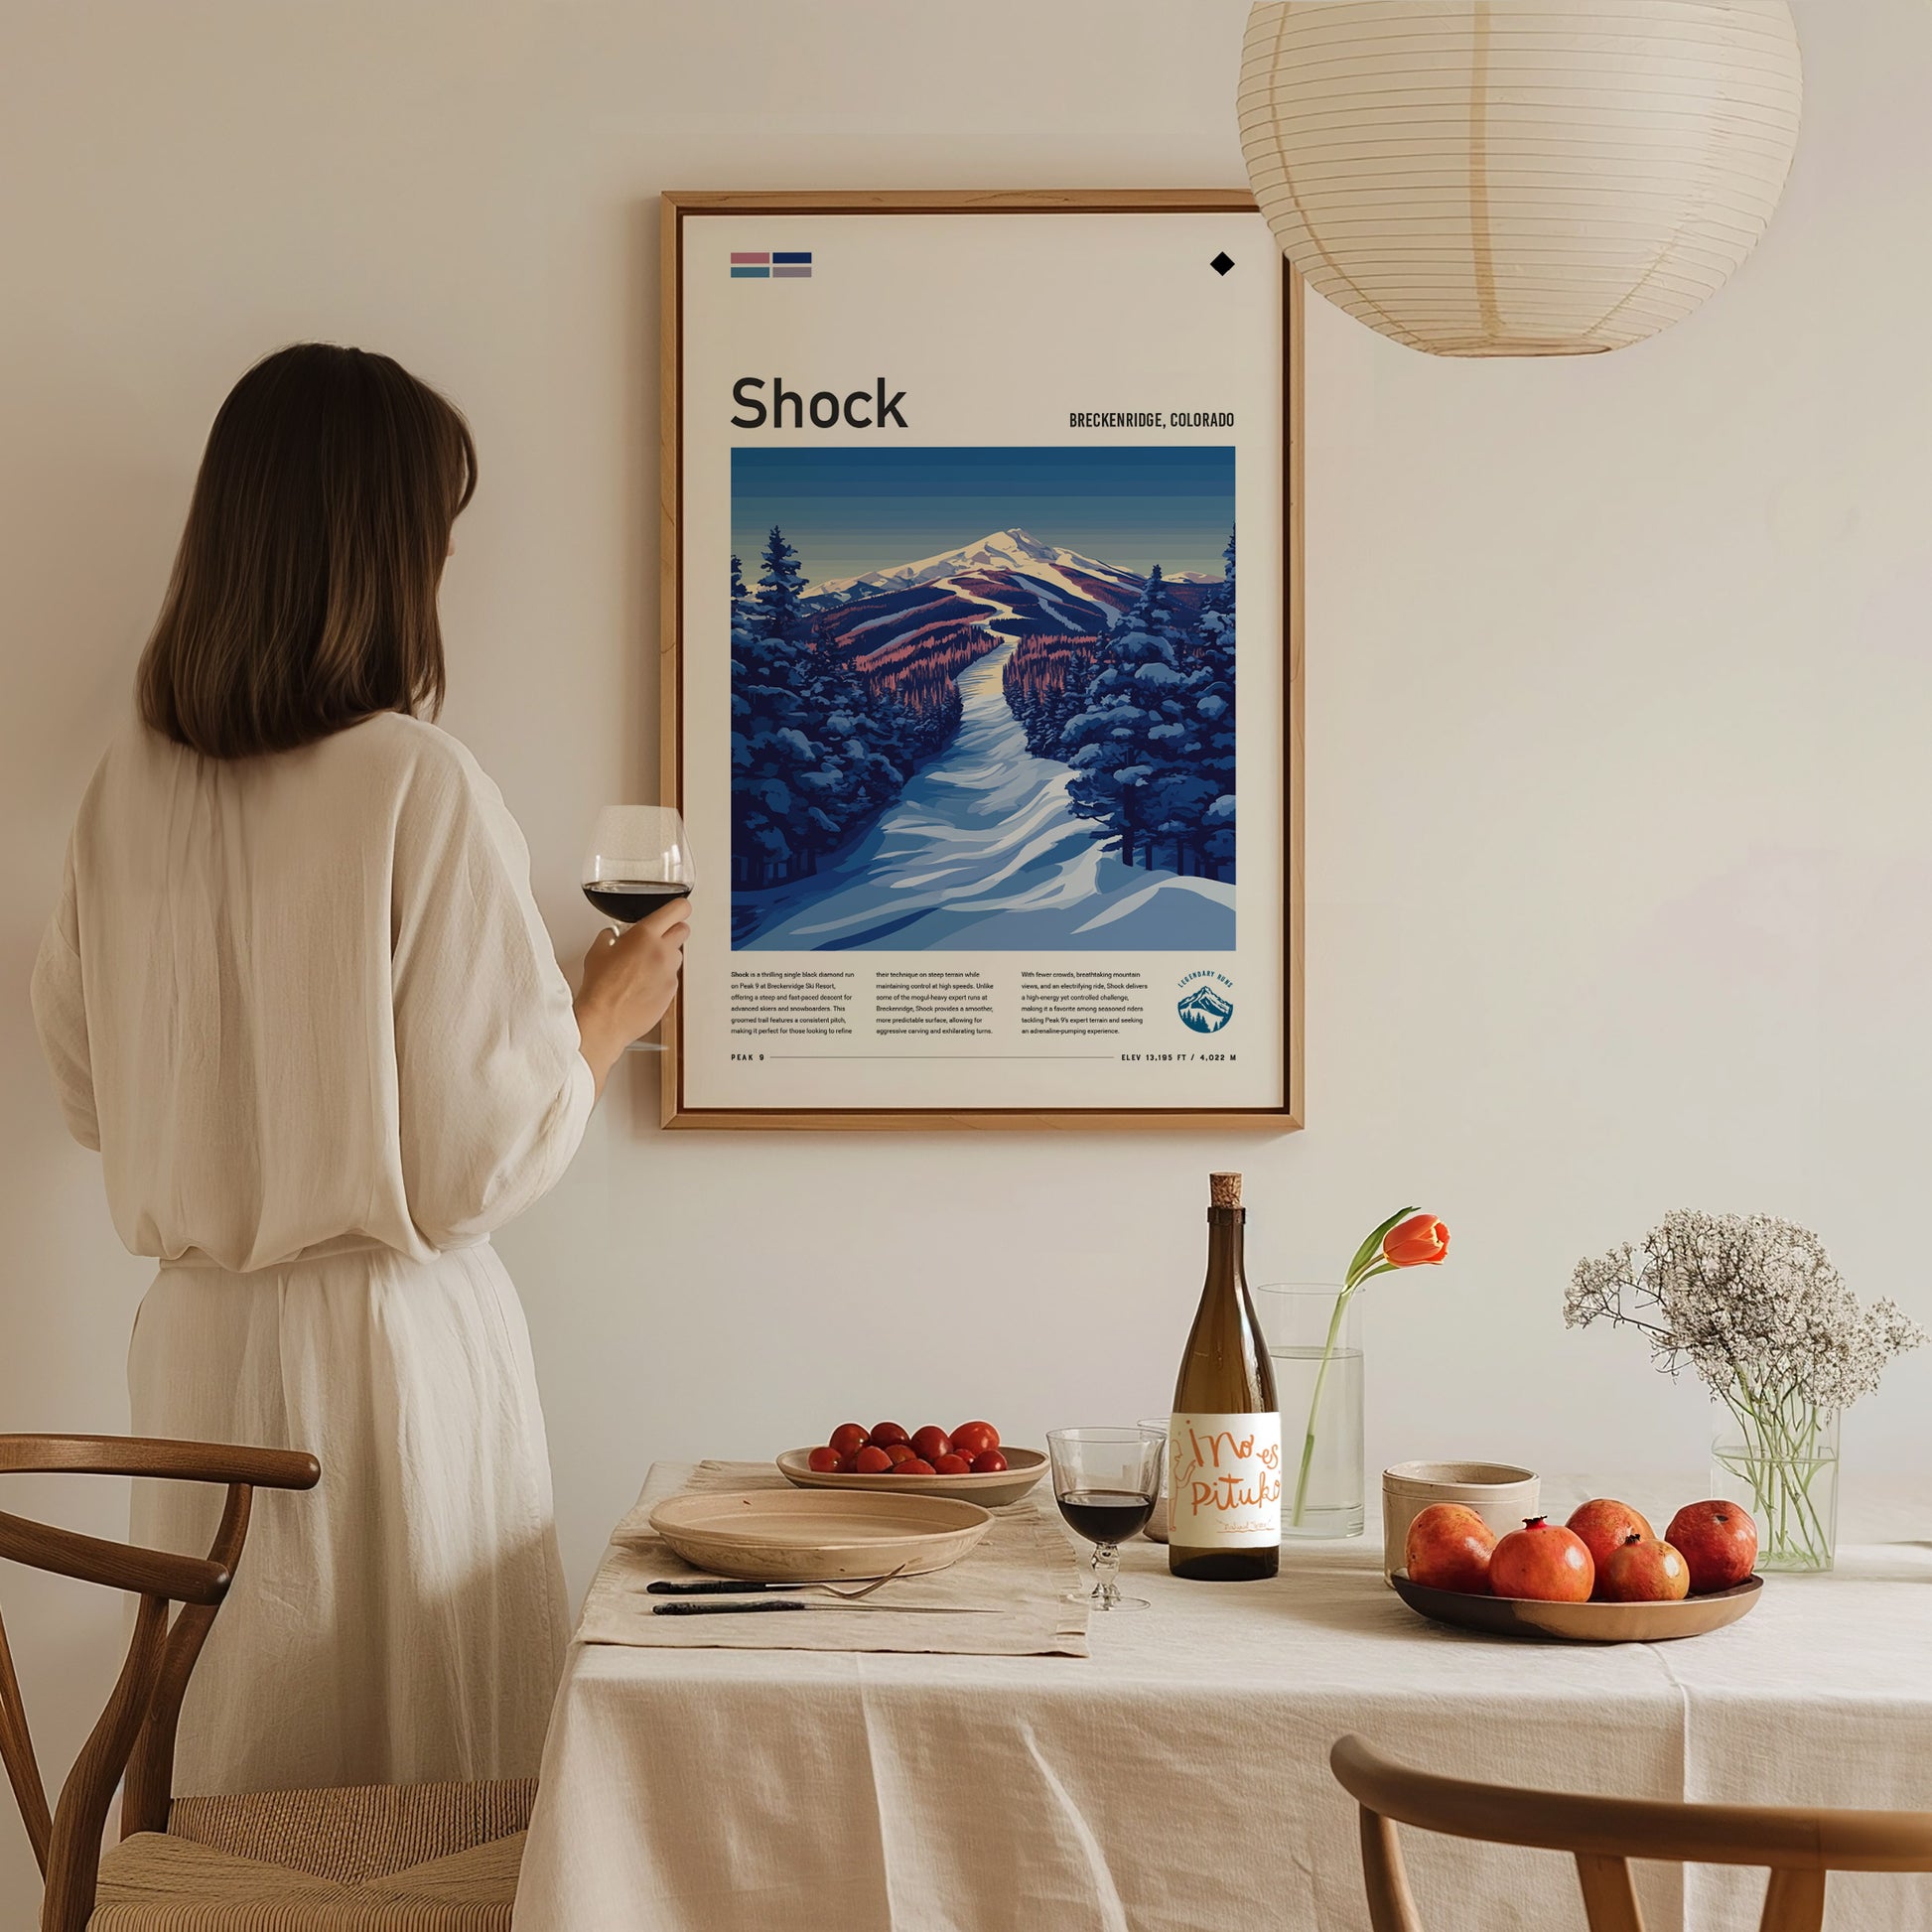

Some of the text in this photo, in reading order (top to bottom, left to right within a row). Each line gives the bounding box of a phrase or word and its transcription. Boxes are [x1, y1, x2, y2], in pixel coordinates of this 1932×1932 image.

[730, 377, 909, 429] Shock
[1070, 412, 1234, 429] BRECKENRIDGE, COLORADO
[1177, 970, 1234, 988] LEGENDARY RUNS
[767, 982, 805, 991] Breckenridge
[730, 994, 754, 1002] offering
[911, 994, 948, 1002] mogul-heavy
[1026, 994, 1060, 1002] high-energy
[1100, 994, 1129, 1002] challenge,
[1021, 1005, 1043, 1013] making
[806, 1028, 828, 1036] looking
[1256, 1444, 1279, 1469] es
